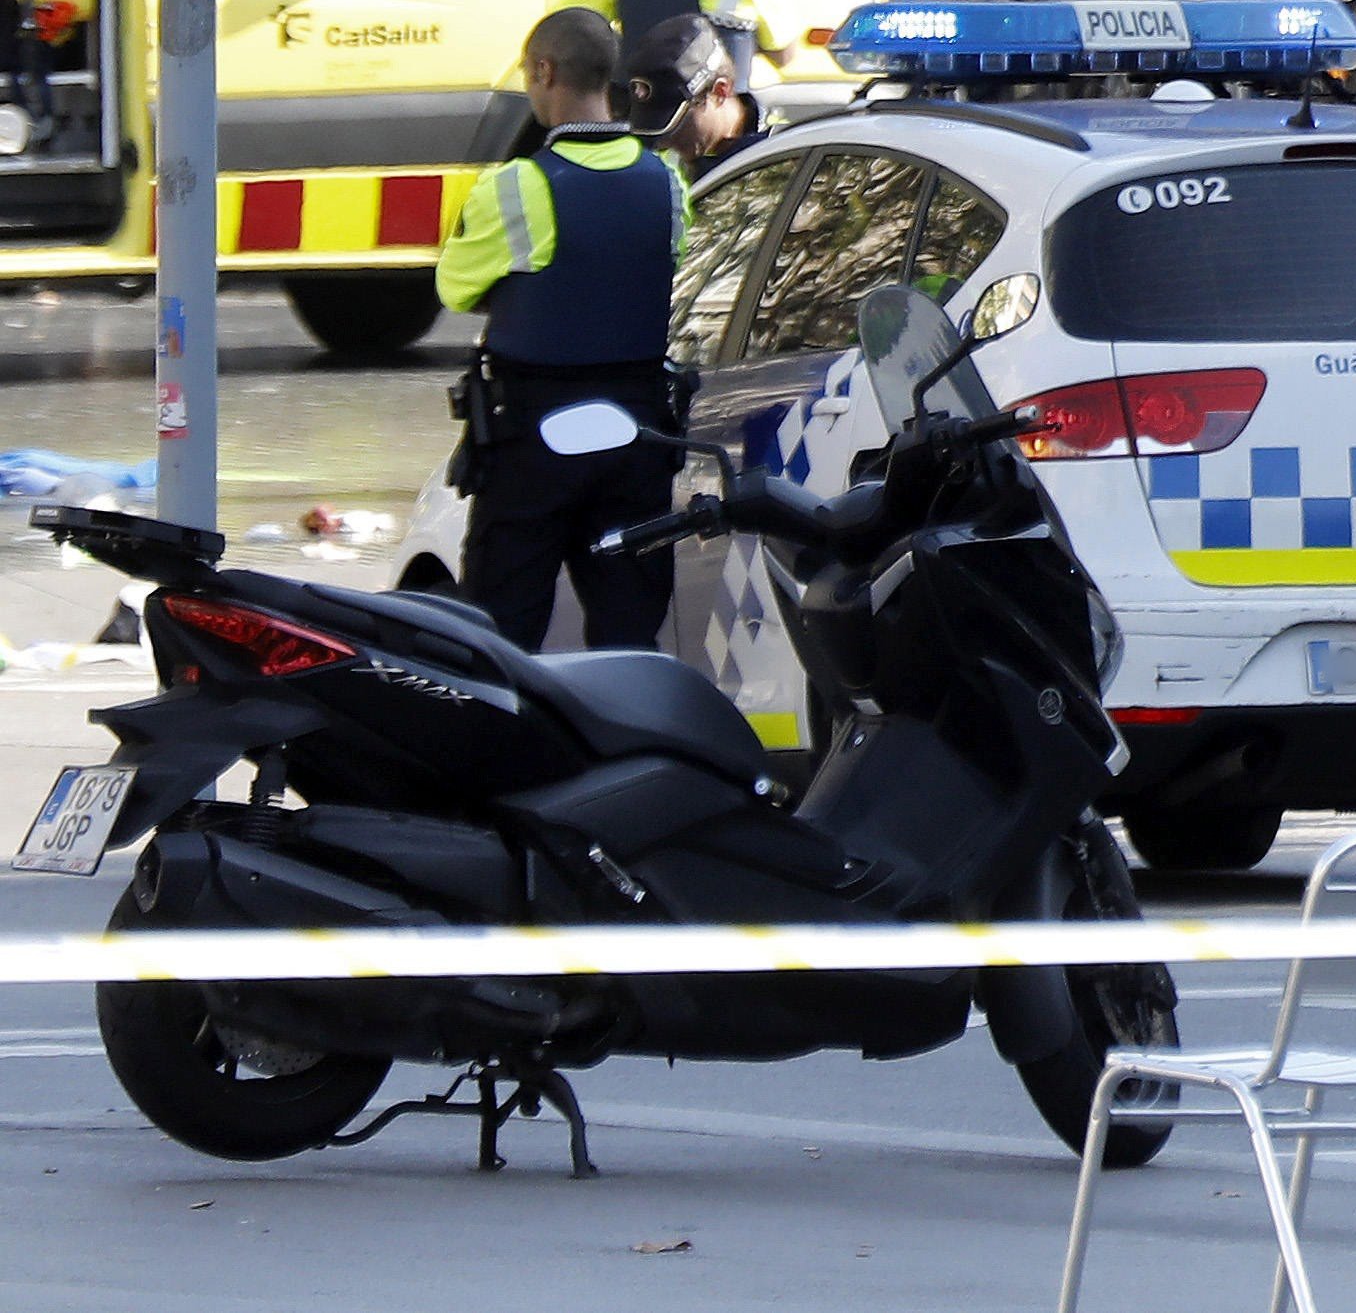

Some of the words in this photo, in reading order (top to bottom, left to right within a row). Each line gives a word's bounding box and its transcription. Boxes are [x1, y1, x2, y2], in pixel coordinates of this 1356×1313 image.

[325, 22, 441, 48] CatSalut
[1087, 9, 1178, 38] POLICIA
[1155, 176, 1233, 209] 092
[65, 773, 126, 813] 1679
[43, 813, 93, 852] JGP
